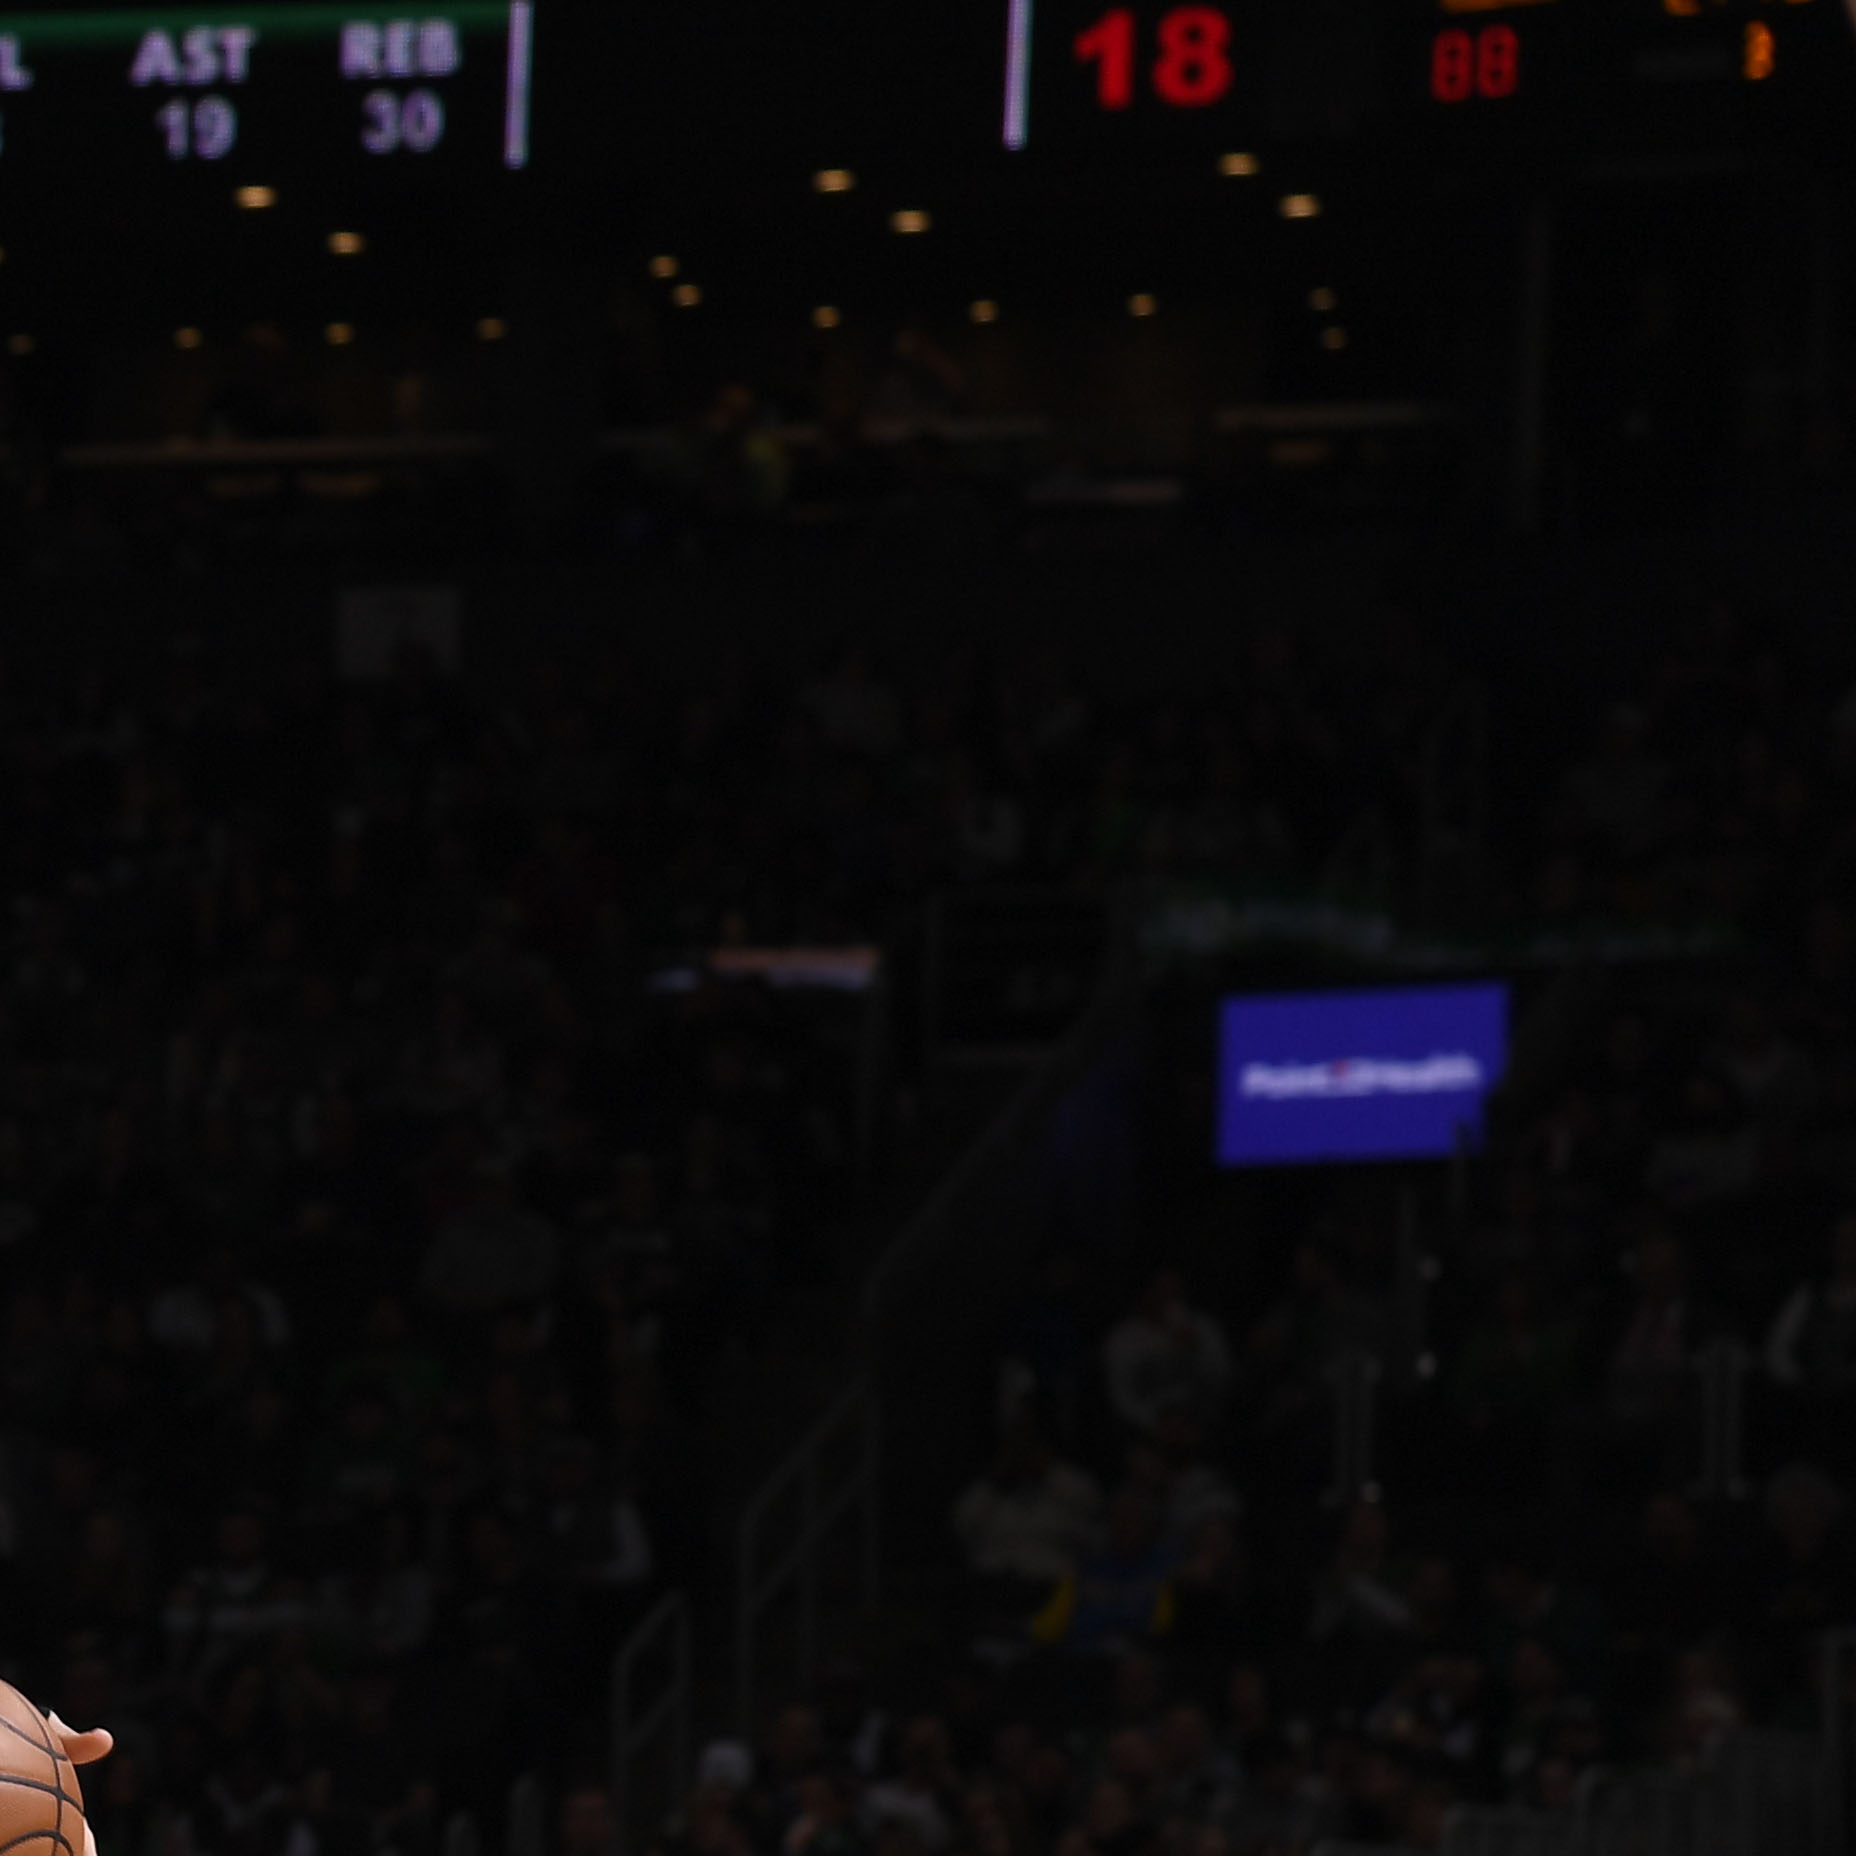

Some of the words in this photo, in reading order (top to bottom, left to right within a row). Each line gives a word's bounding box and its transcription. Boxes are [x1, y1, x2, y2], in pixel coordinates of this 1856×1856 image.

[129, 26, 255, 86] AST
[340, 19, 458, 79] REB
[1075, 5, 1232, 110] 18
[154, 95, 236, 160] 19
[361, 90, 444, 153] 30
